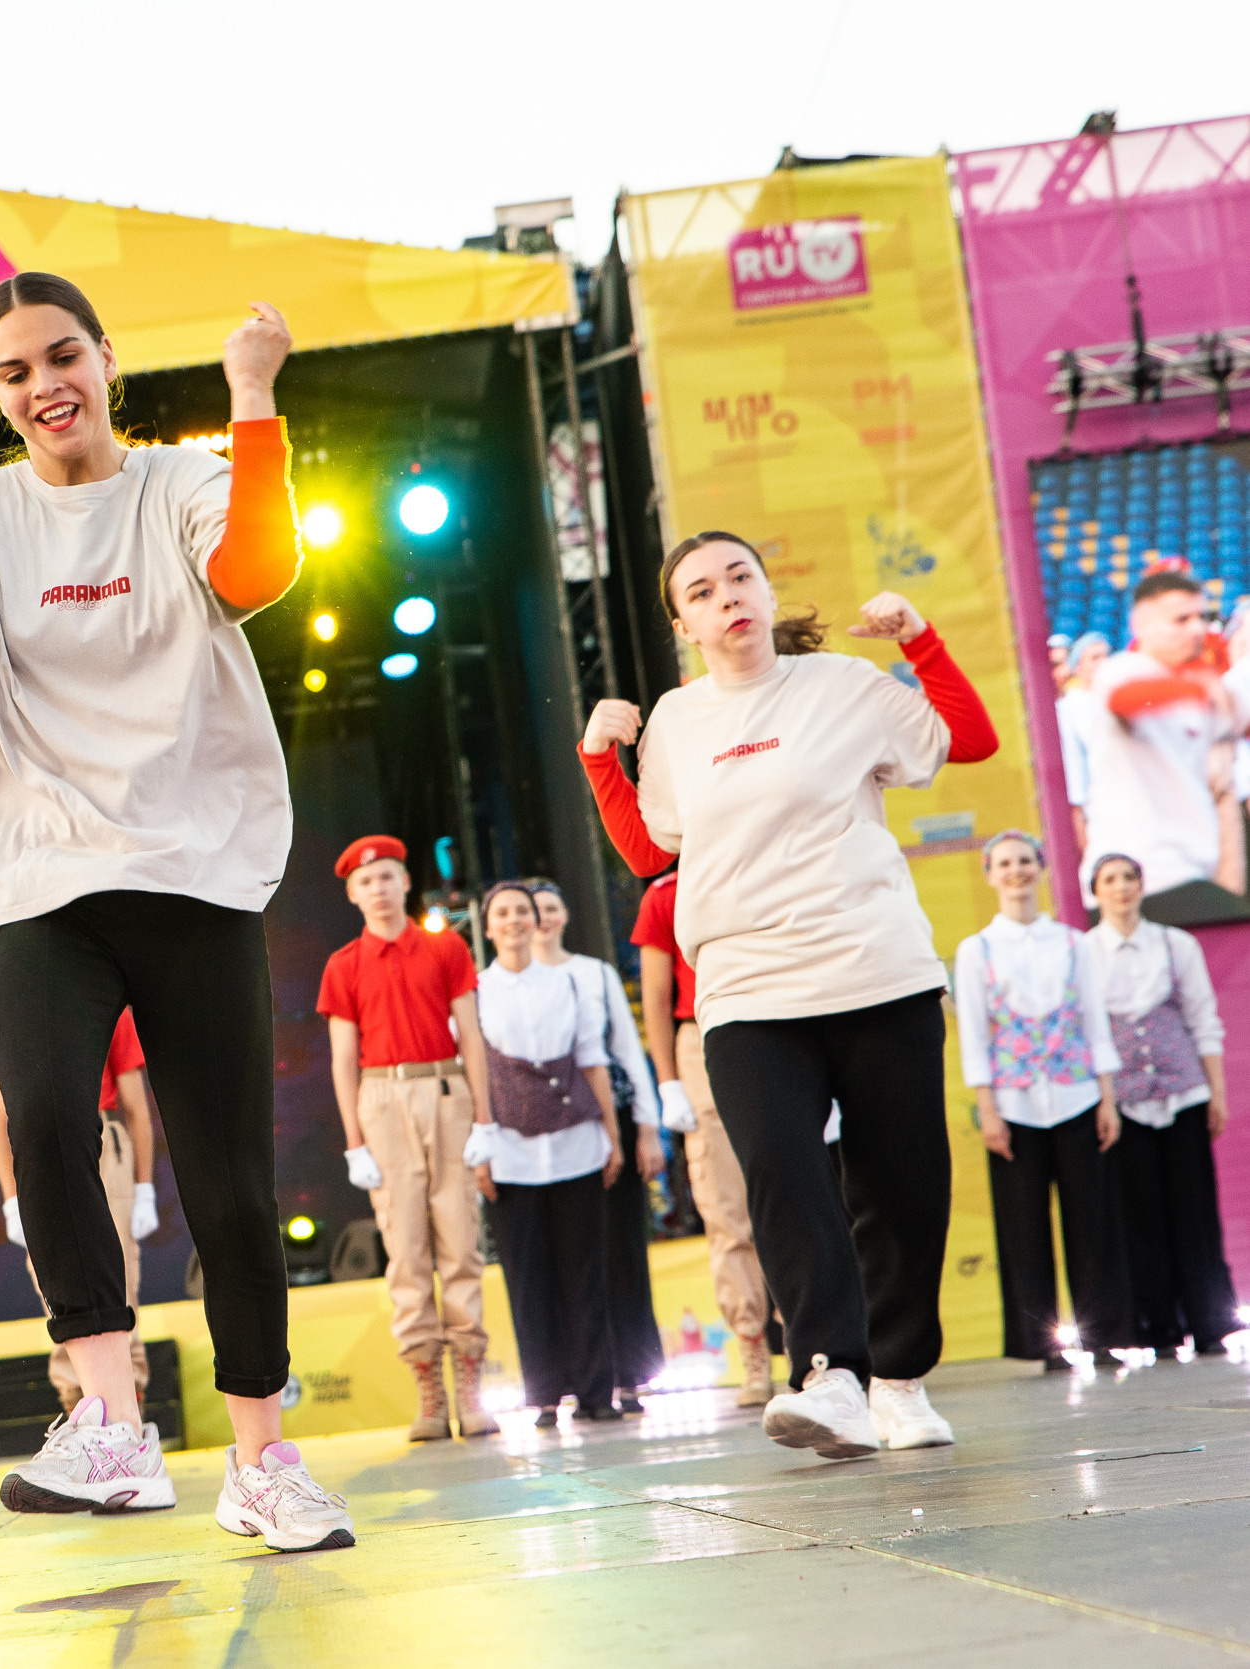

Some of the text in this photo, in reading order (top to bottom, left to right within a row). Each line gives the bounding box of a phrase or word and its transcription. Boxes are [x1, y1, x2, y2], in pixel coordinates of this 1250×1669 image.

[735, 243, 844, 282] RU TV
[40, 576, 131, 608] PARANOID
[712, 738, 779, 766] PARANOID
